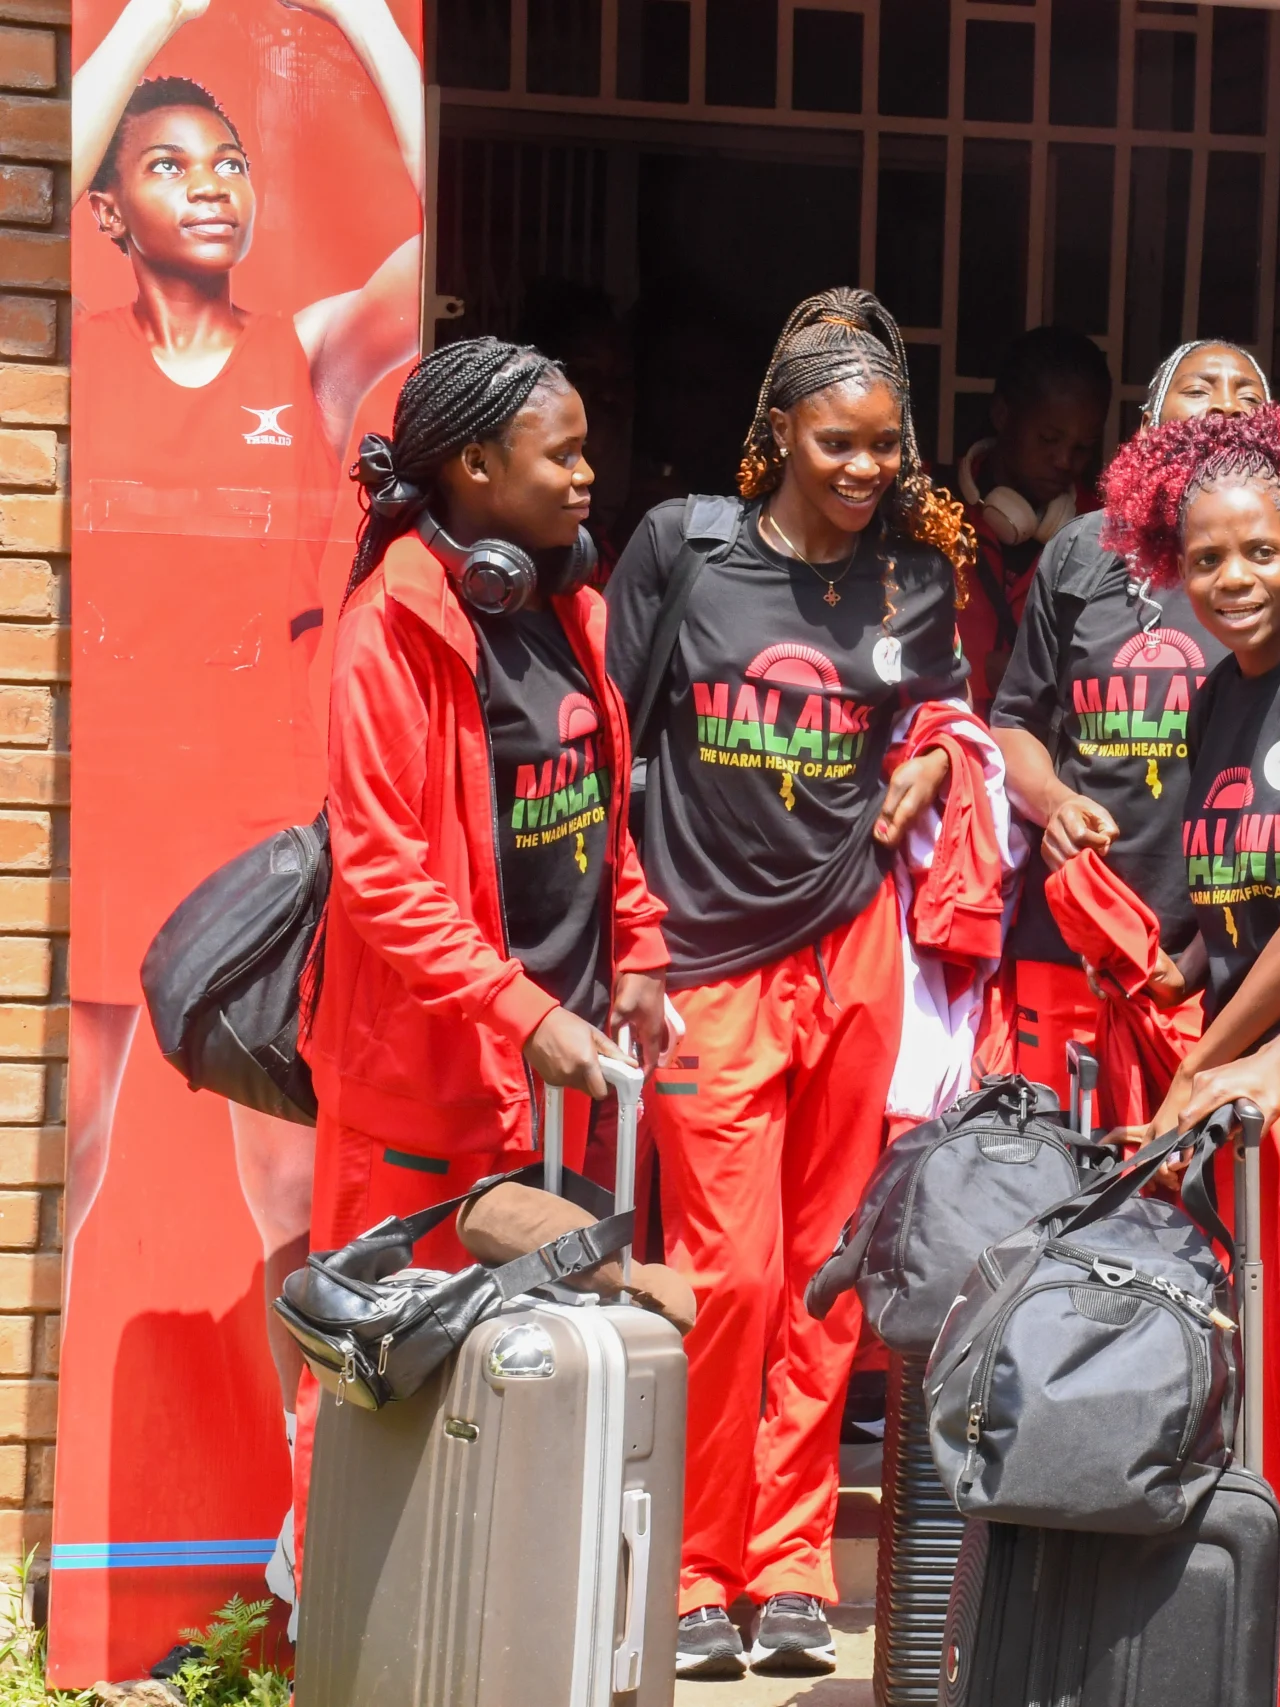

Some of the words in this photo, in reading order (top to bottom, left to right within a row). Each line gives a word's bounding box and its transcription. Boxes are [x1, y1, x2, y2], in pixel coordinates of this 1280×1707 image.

[1073, 675, 1207, 740] MALA
[700, 747, 717, 763] THE
[719, 751, 762, 769] WARM
[765, 755, 801, 775] HEART
[803, 762, 823, 778] OF
[1078, 743, 1099, 756] THE
[1098, 743, 1129, 757] WARM
[1131, 742, 1173, 757] HEART
[1176, 743, 1188, 758] O
[511, 734, 609, 830] MALA
[515, 833, 539, 849] THE
[541, 822, 568, 845] WARM
[568, 811, 592, 835] HEART
[592, 806, 606, 824] OF
